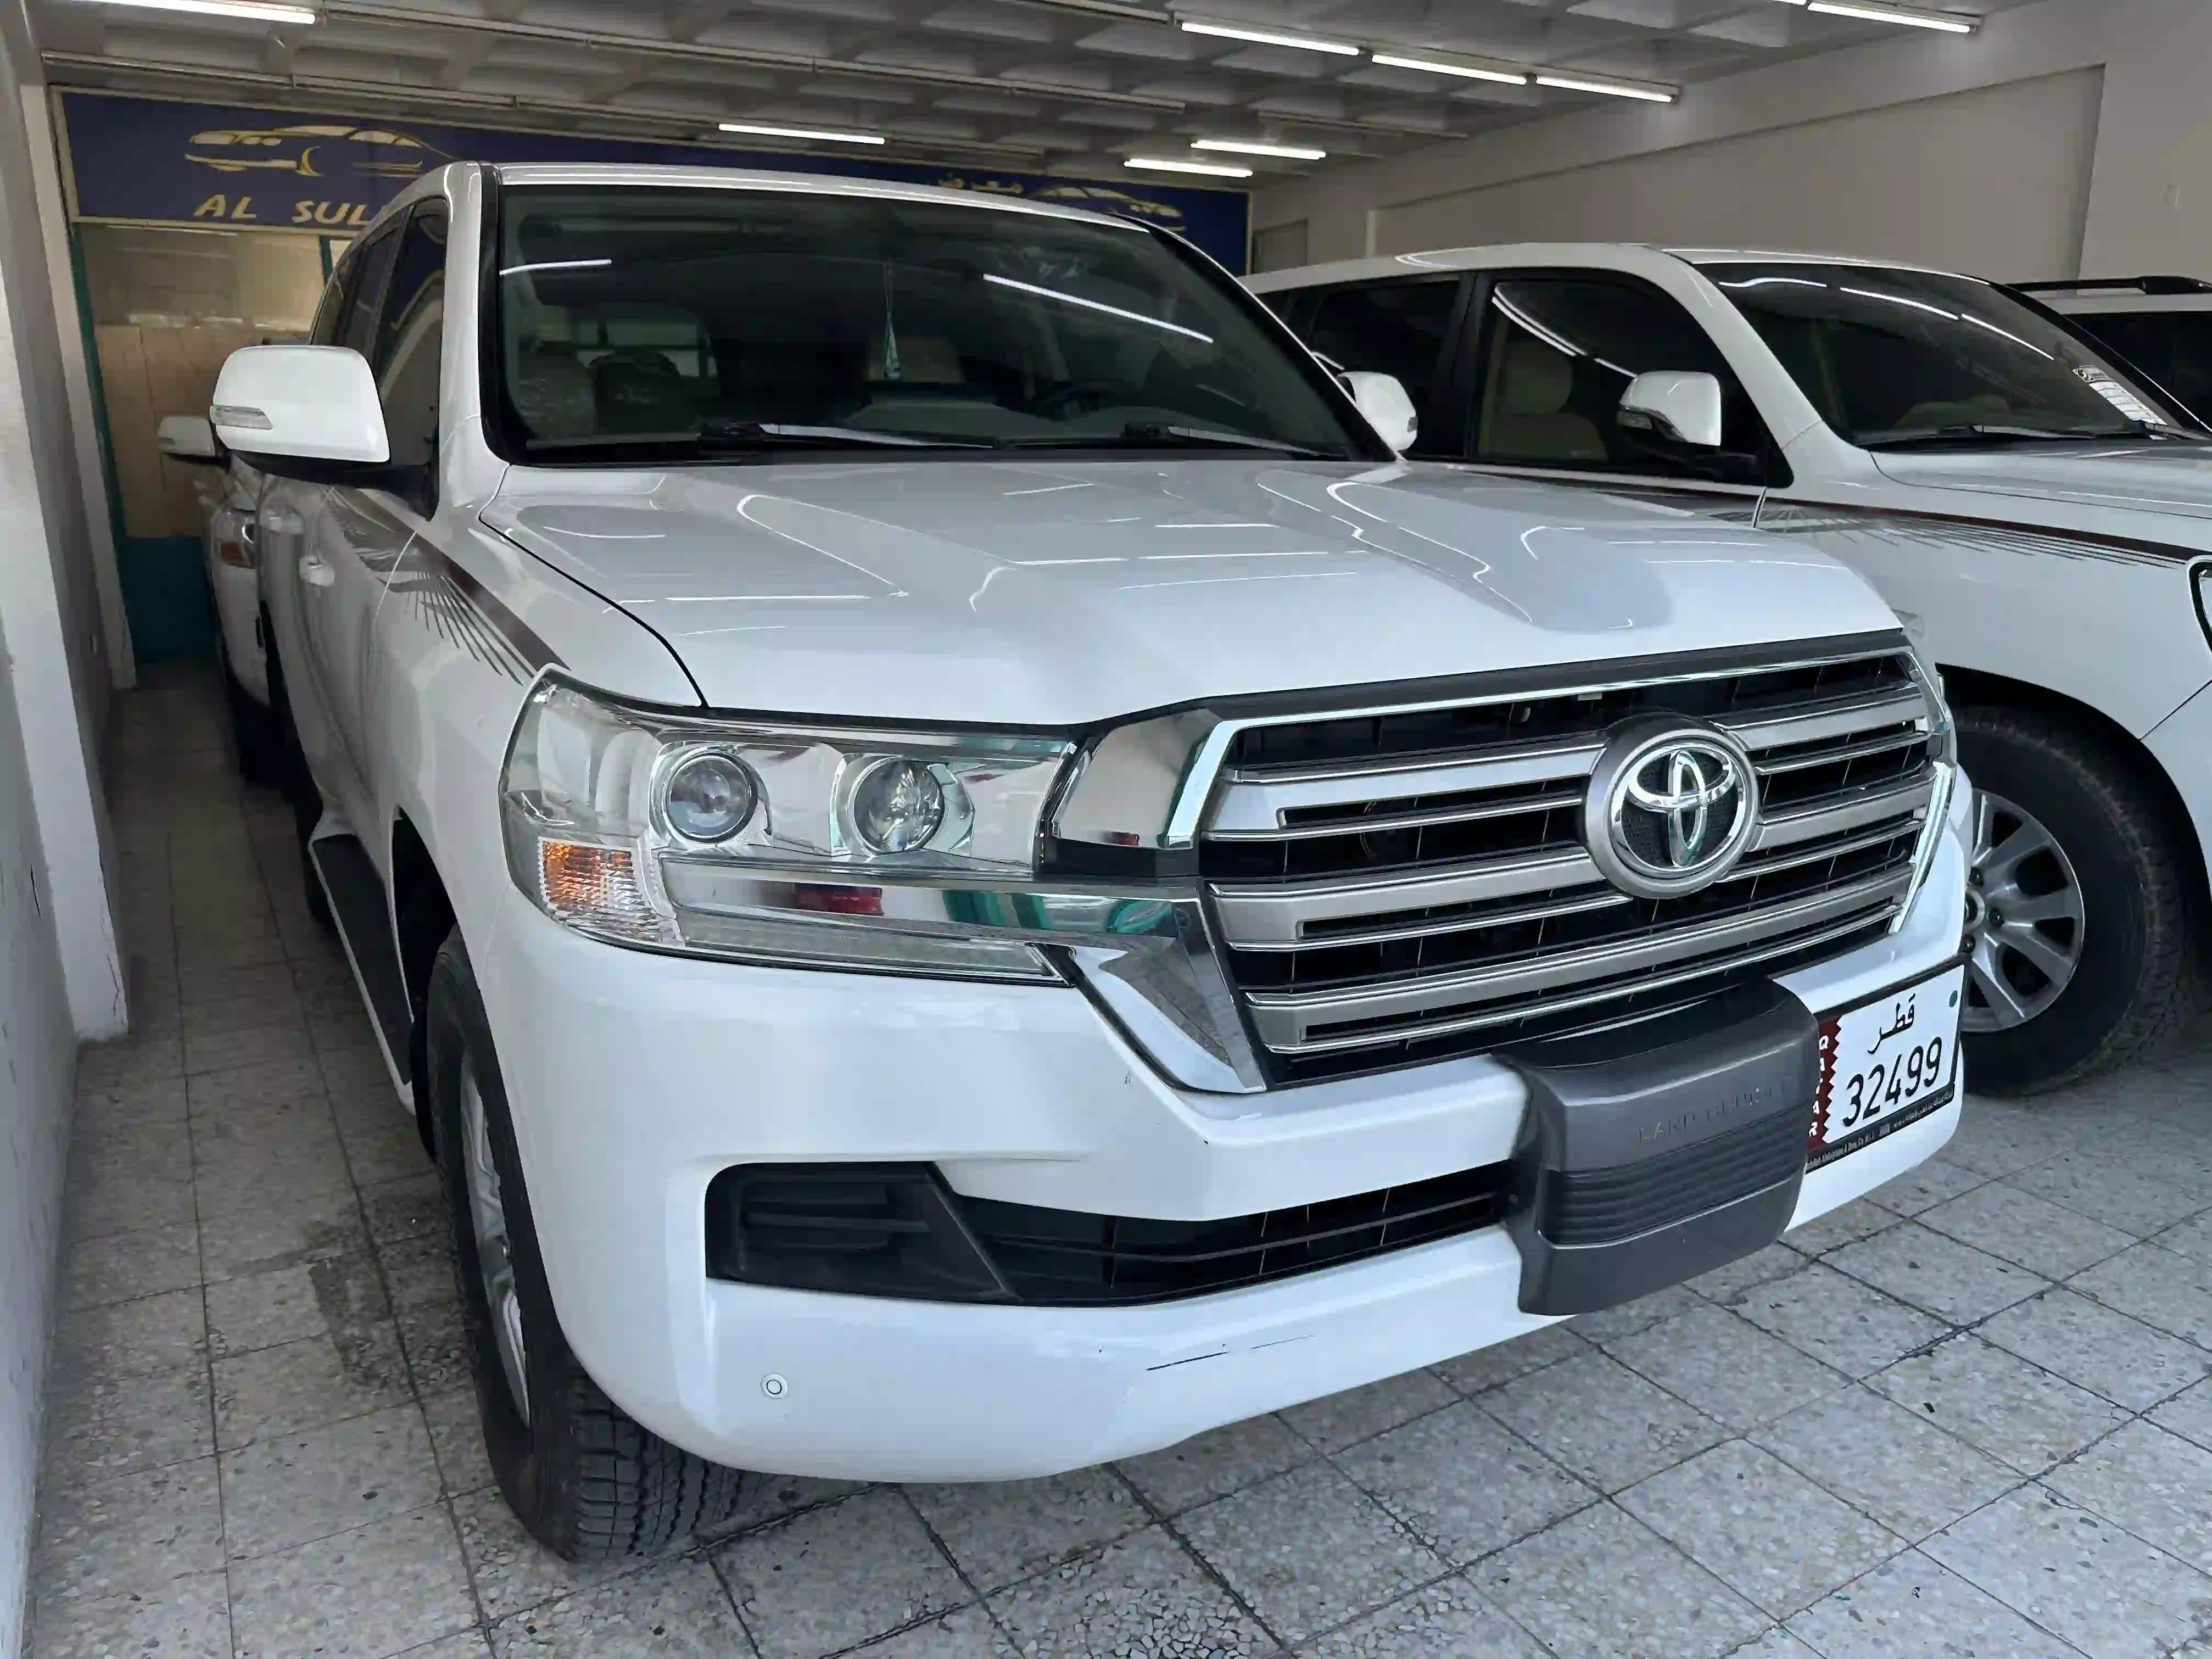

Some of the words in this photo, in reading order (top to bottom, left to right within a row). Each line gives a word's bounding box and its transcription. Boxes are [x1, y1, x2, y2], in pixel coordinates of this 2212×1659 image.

[193, 193, 257, 219] AL
[1867, 993, 1917, 1055] قطر
[1842, 1036, 1942, 1127] 32499
